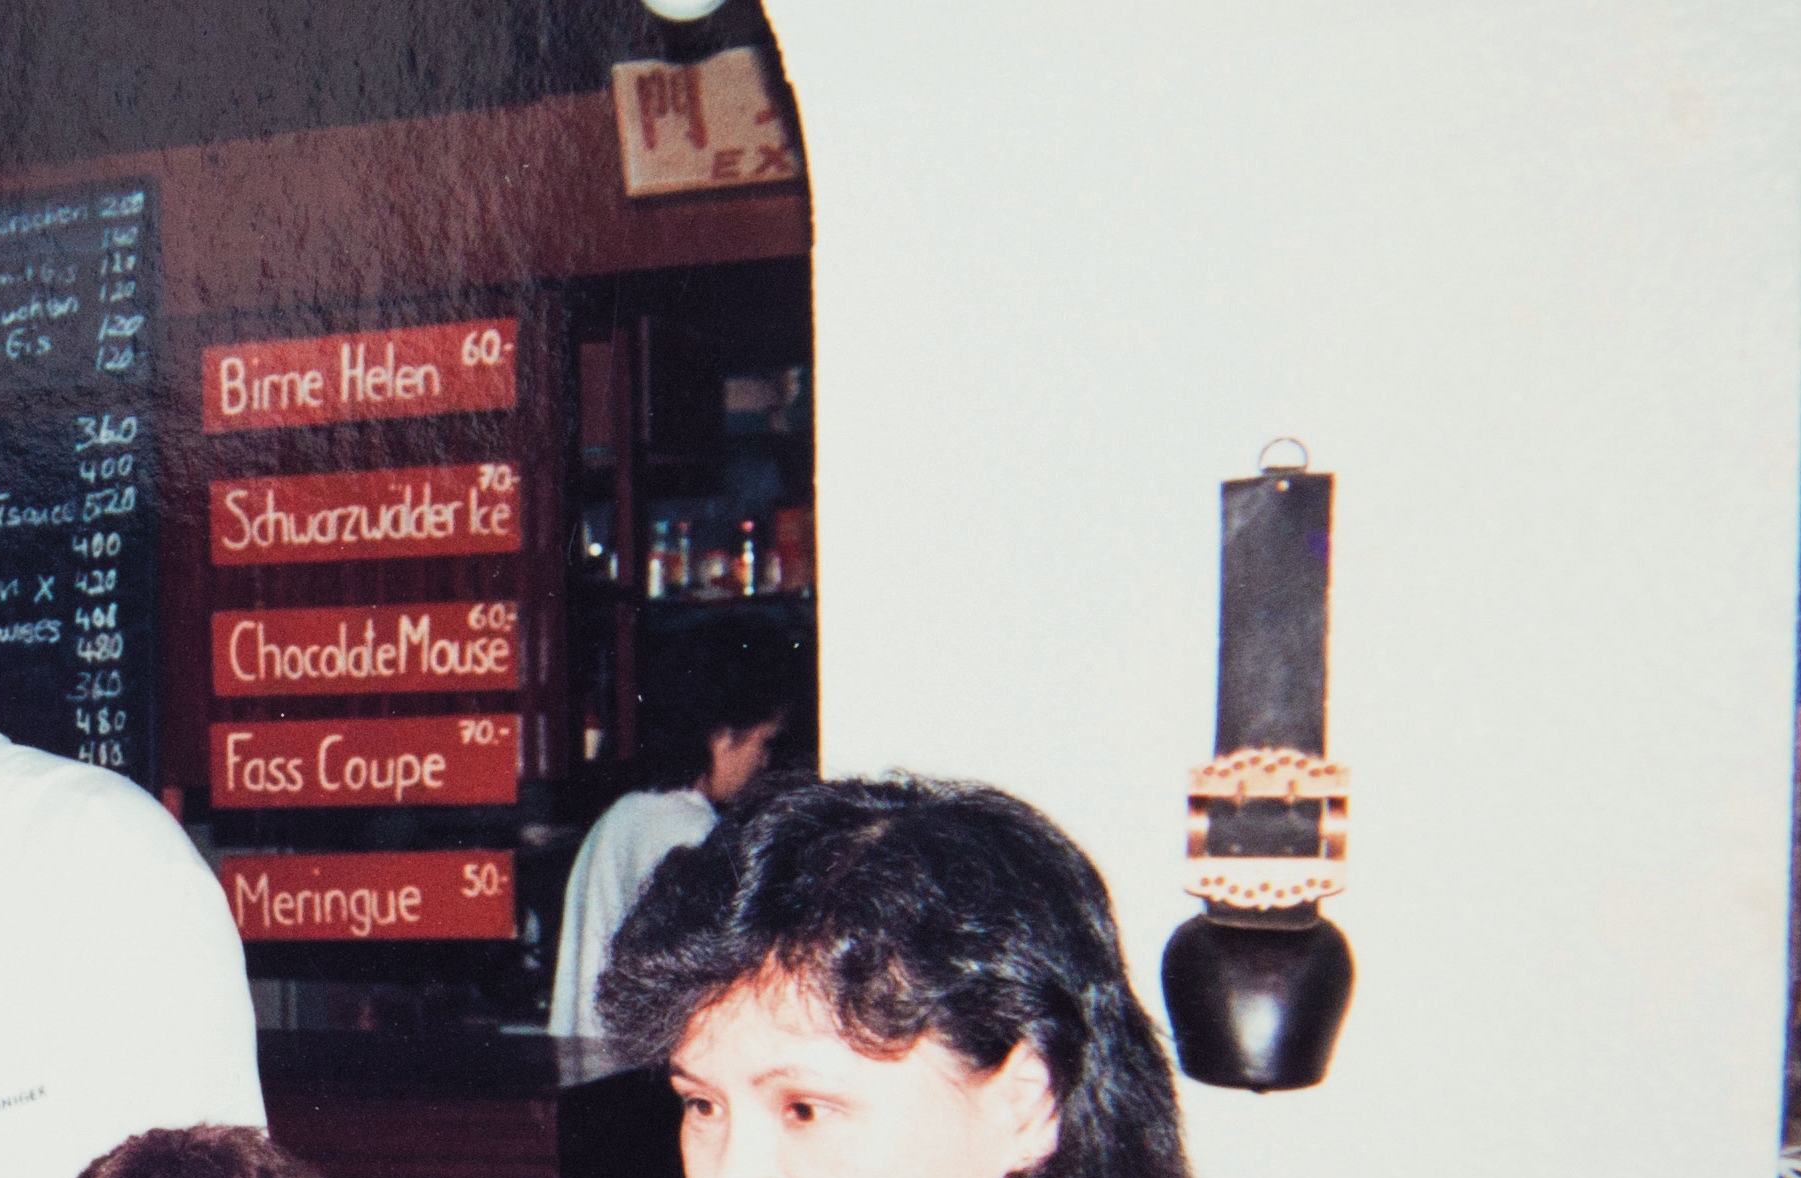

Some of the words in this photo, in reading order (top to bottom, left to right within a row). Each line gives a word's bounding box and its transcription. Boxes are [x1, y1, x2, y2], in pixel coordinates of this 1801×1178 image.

[219, 356, 324, 416] Birne
[339, 340, 440, 400] Helen
[225, 732, 304, 793] Fass
[316, 734, 447, 803] Coupe
[235, 873, 423, 938] Meringue
